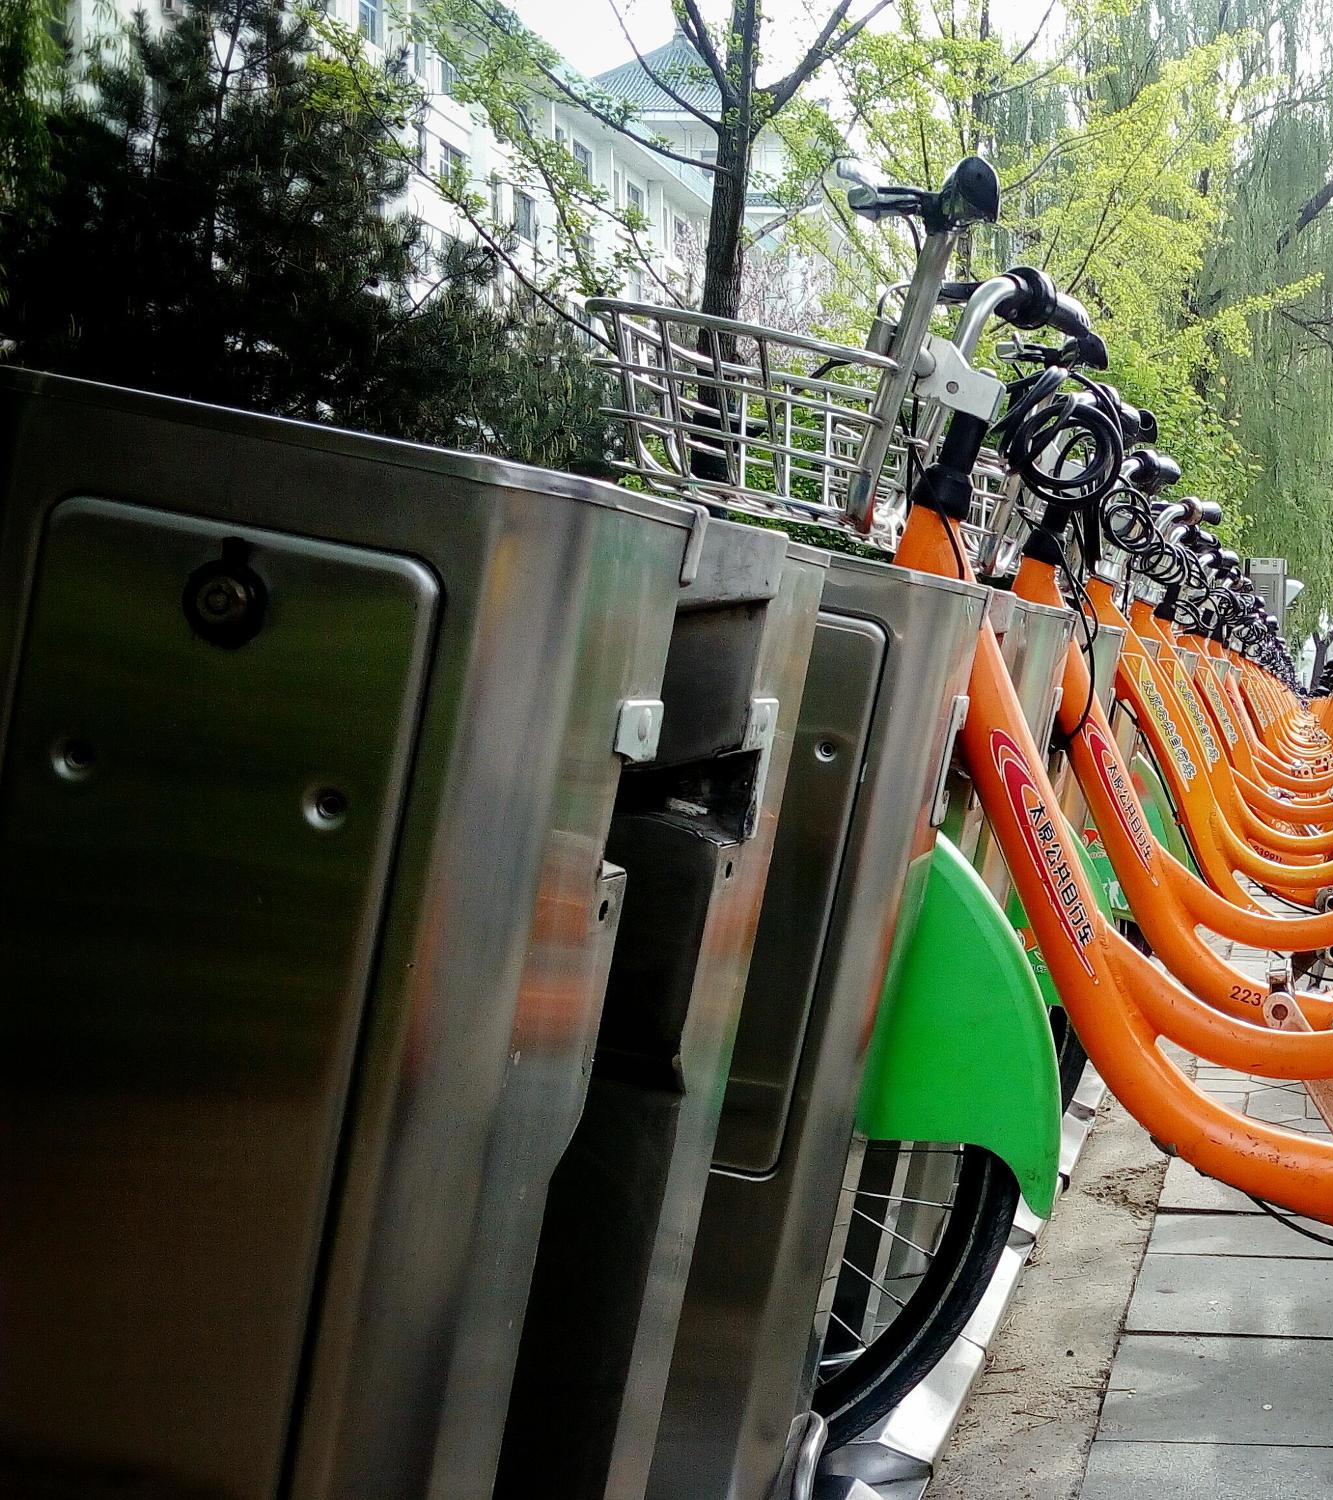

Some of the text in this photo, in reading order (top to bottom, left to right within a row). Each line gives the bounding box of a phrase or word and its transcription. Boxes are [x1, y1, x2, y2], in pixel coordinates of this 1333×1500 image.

[1142, 680, 1197, 779] 太原公共自行车
[1107, 761, 1152, 860] 太原公共自行车
[1029, 801, 1095, 946] 太原公共自行车
[1230, 985, 1262, 1007] 223
